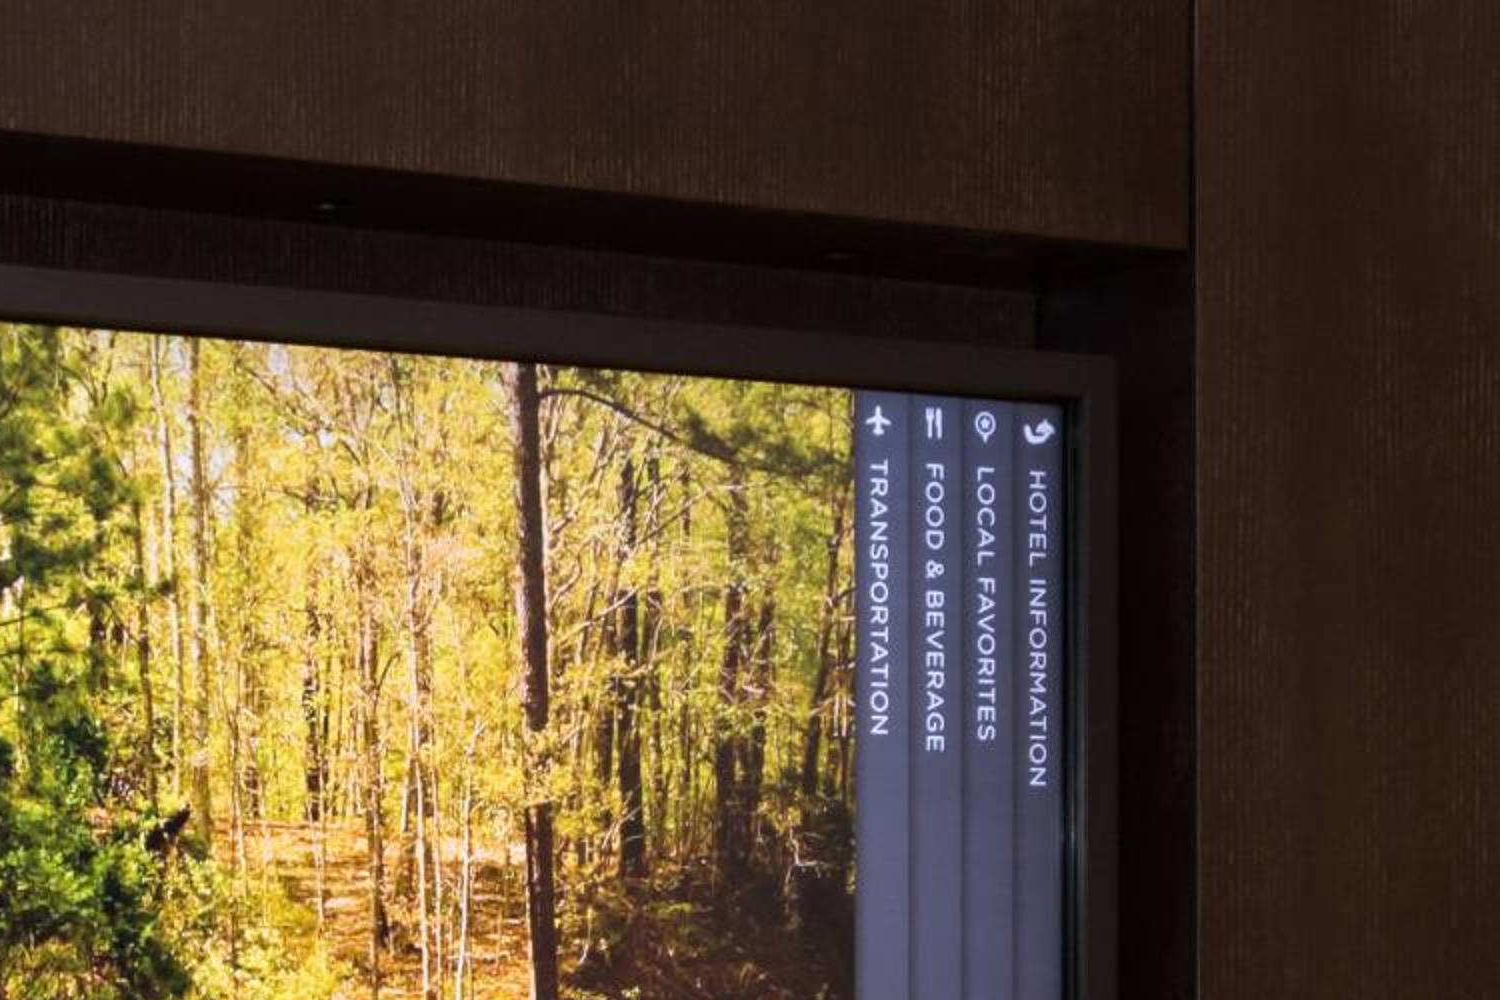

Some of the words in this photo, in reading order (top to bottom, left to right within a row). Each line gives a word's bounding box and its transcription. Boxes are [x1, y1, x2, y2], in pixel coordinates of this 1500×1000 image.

[926, 464, 944, 549] FOOD
[926, 560, 944, 578] &
[977, 467, 995, 565] LOCAL
[1029, 471, 1046, 566] HOTEL
[870, 460, 888, 734] TRANSPORTATION
[978, 578, 995, 740] FAVORITES
[926, 591, 944, 751] BEVERAGE
[1029, 580, 1046, 785] INFORMATION
